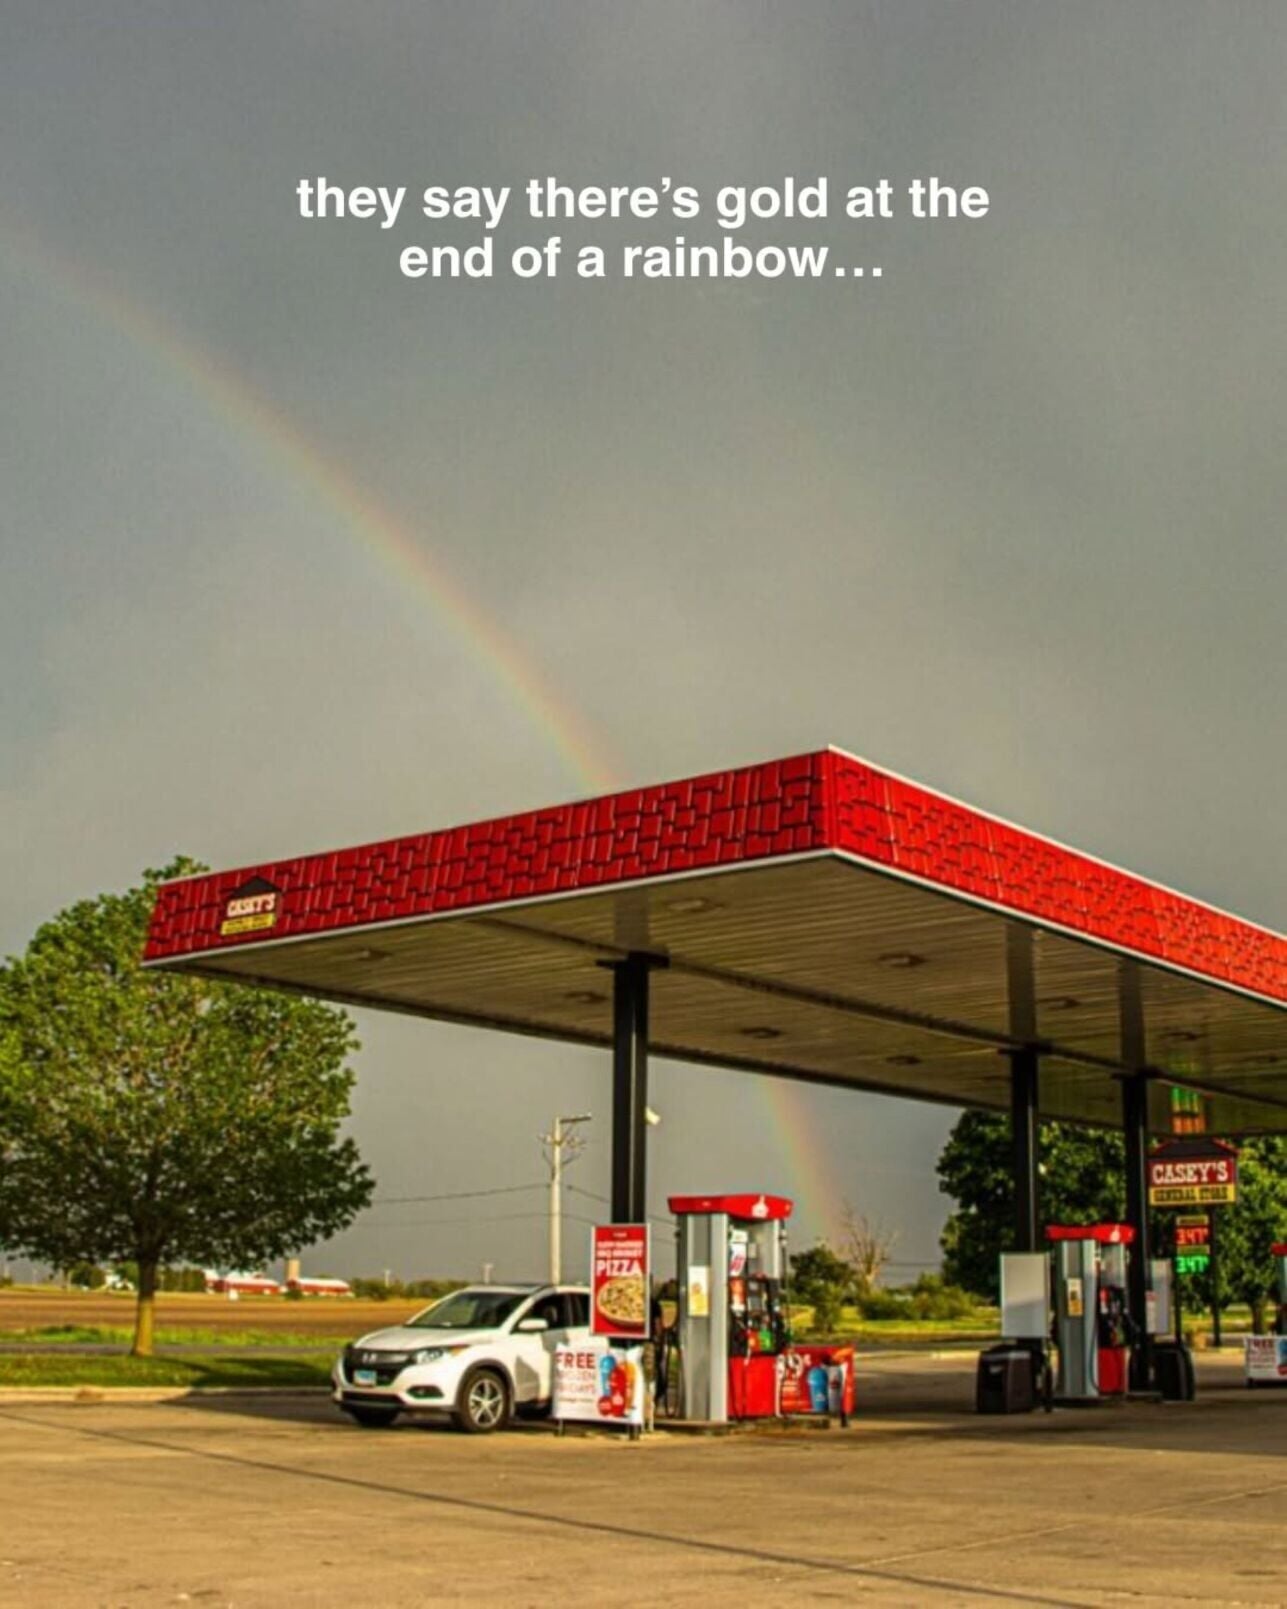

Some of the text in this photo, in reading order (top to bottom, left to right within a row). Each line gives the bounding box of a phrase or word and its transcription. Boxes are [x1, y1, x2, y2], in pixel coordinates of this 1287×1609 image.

[1152, 1161, 1228, 1184] CASEY'S
[596, 1259, 643, 1277] PIZZA
[555, 1352, 596, 1369] FREE
